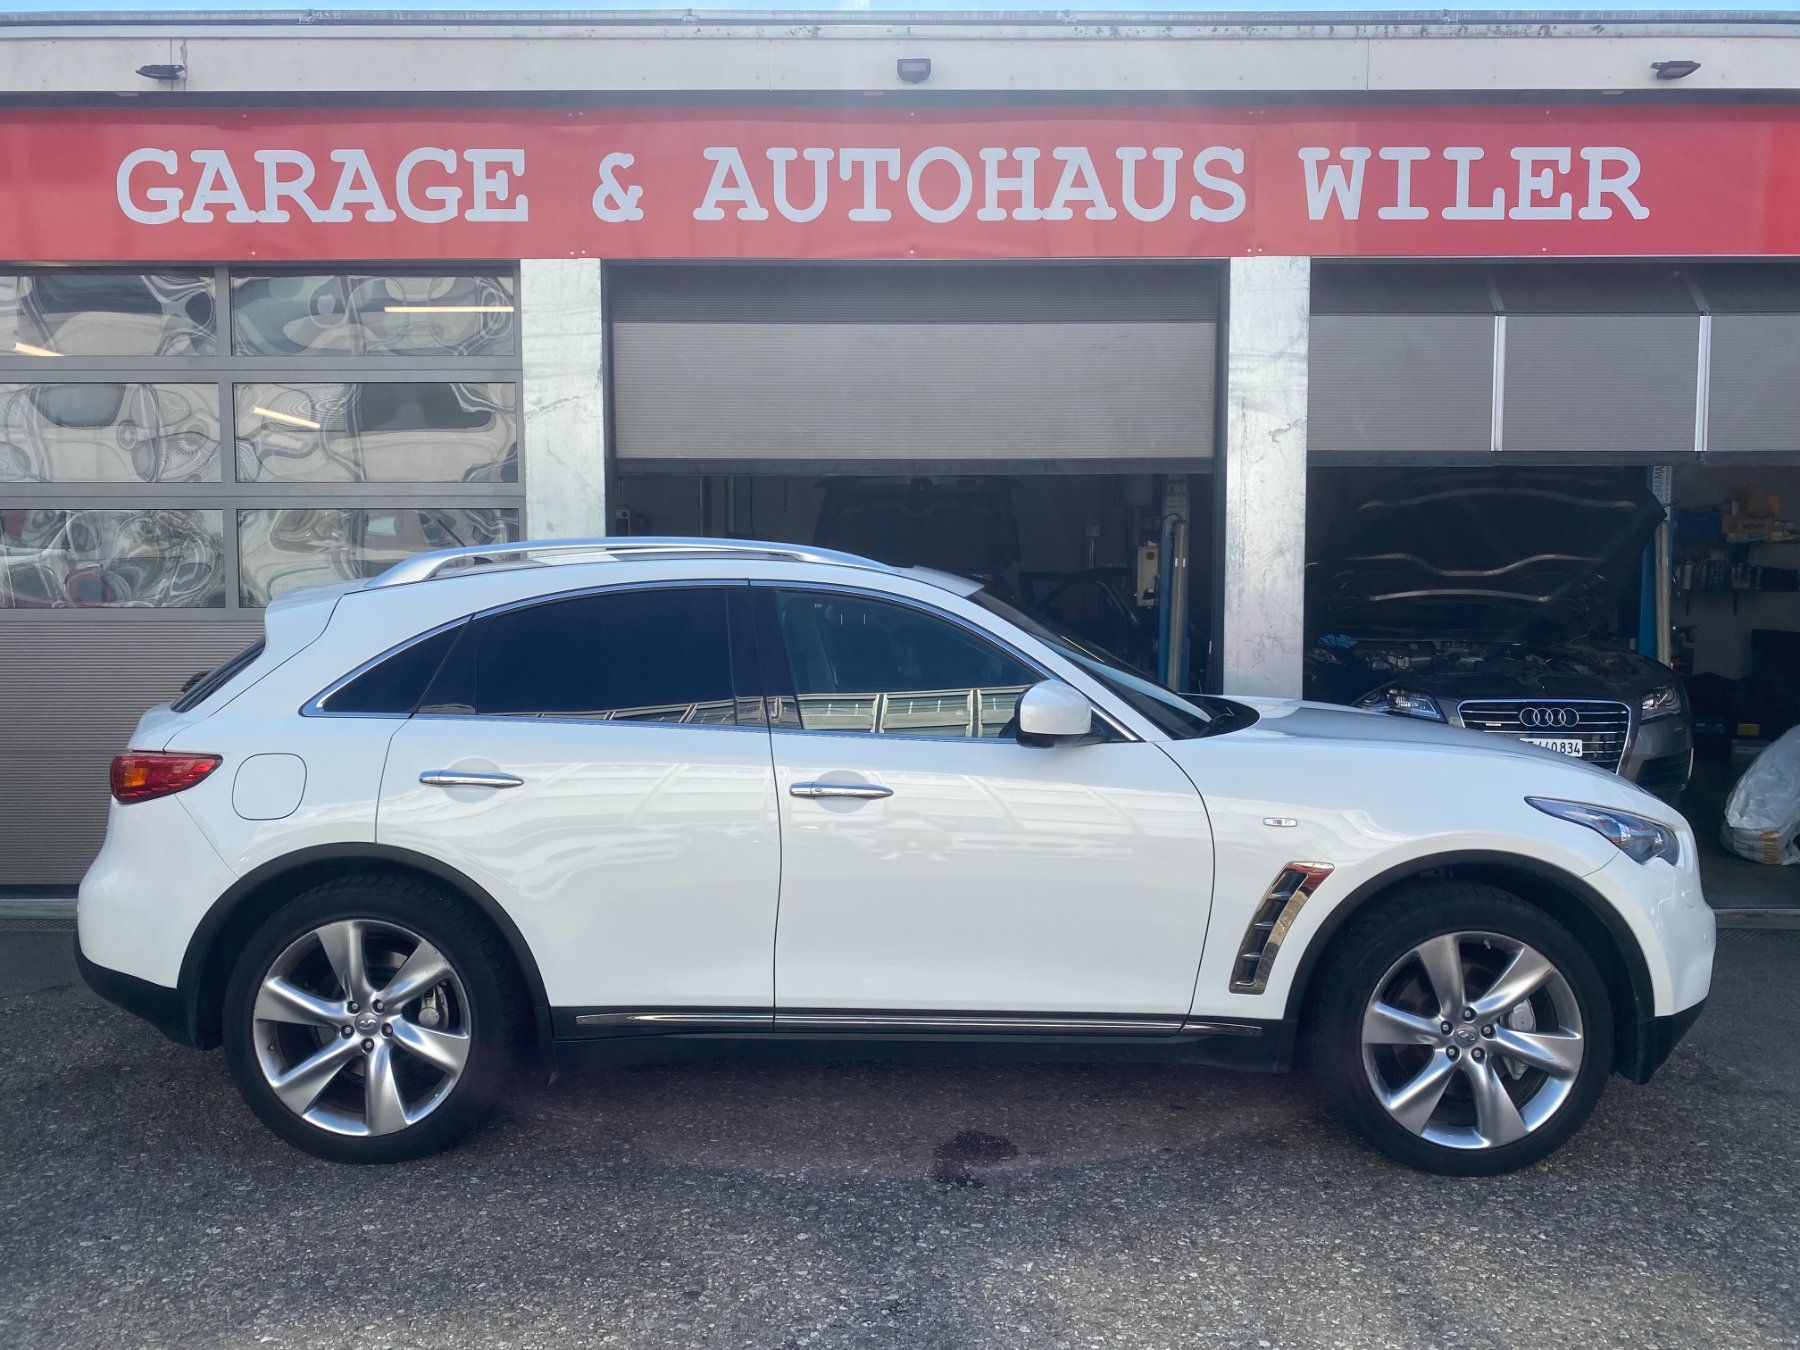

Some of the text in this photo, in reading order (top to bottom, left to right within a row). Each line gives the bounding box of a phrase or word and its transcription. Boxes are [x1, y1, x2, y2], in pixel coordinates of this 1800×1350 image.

[116, 146, 1651, 224] GARAGE & AUTOHAUS WILER
[1538, 741, 1581, 755] 0834
